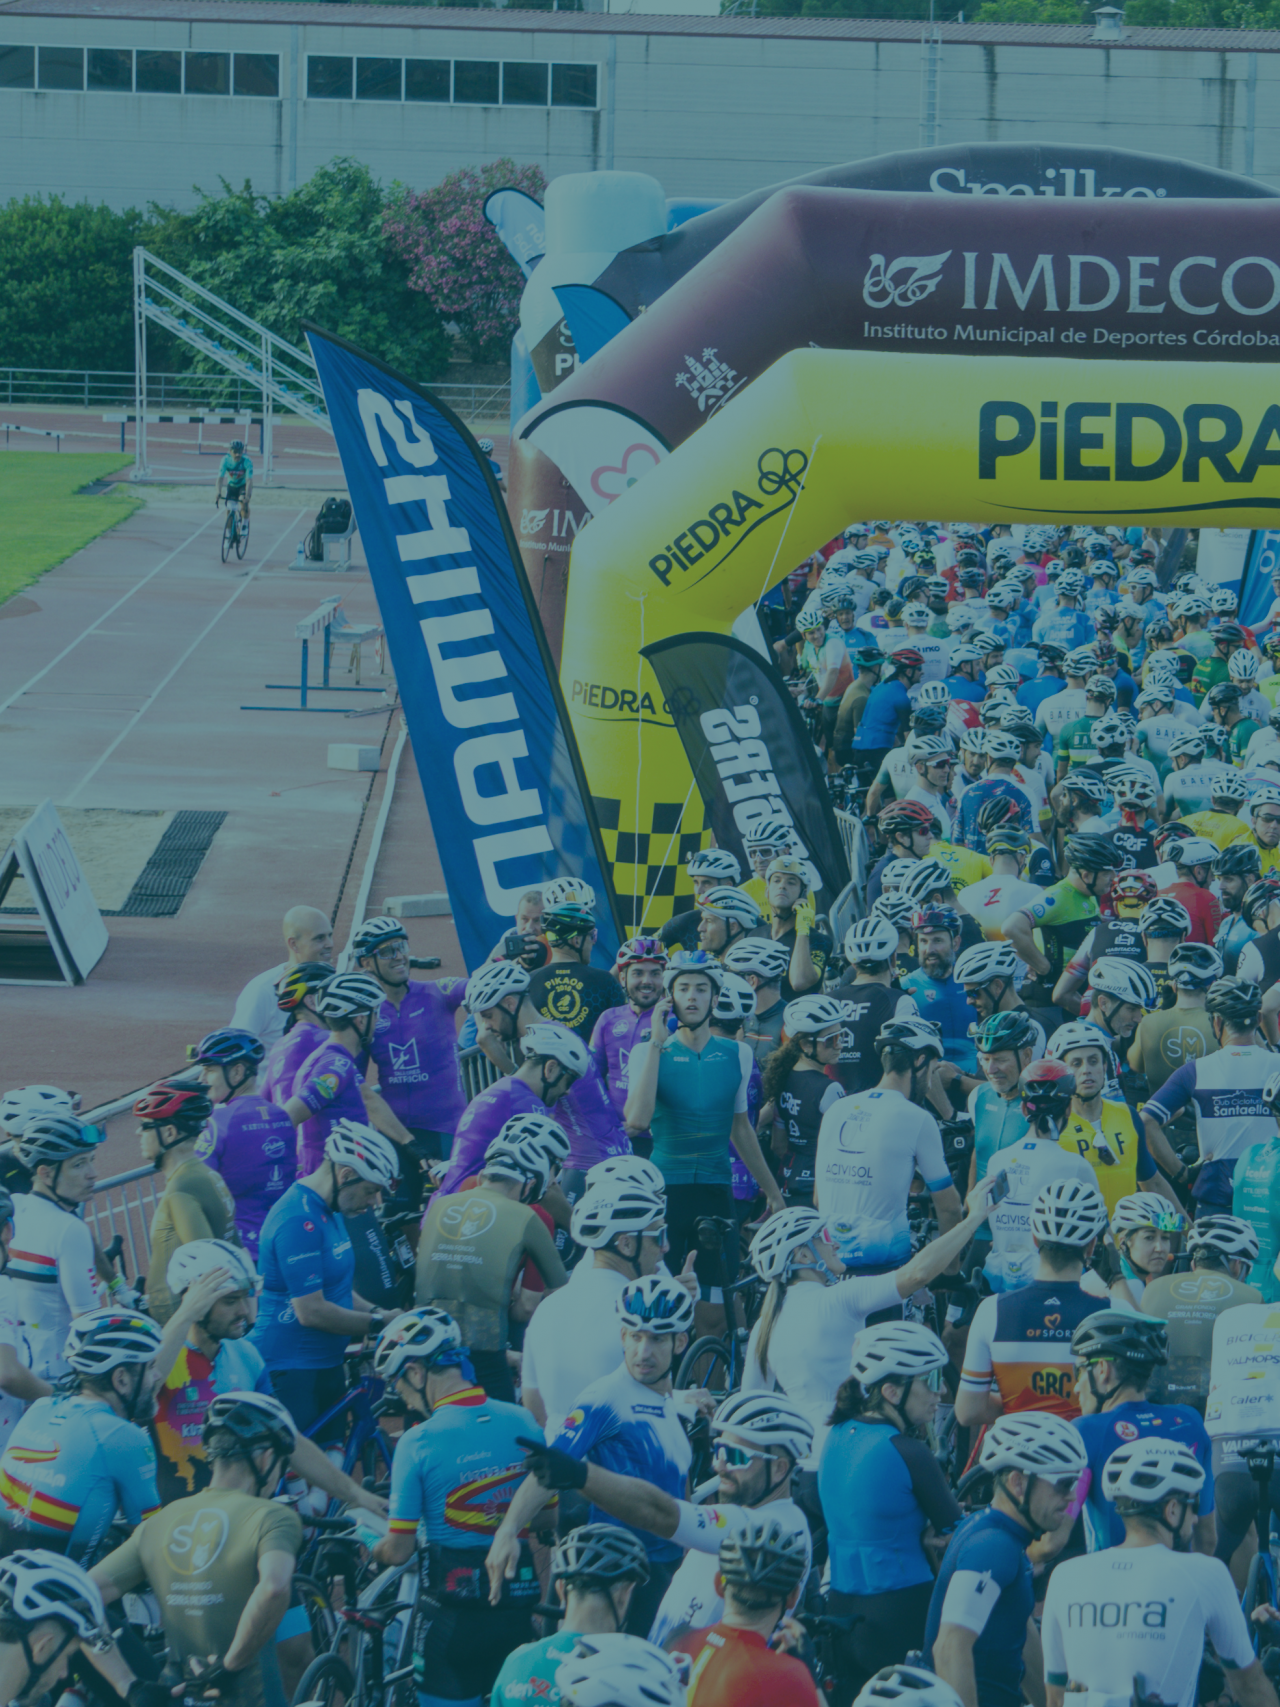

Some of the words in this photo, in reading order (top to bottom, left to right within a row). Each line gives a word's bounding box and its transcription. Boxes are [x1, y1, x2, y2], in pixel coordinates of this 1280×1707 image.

[862, 321, 949, 341] Instituto
[954, 323, 1055, 345] Municipal
[1060, 326, 1088, 344] de
[1092, 328, 1187, 348] Deportes
[1192, 328, 1280, 347] Córdoba
[543, 976, 585, 990] PIKAOS
[388, 1073, 429, 1084] PATRICIO
[1213, 1098, 1230, 1106] Club
[1212, 1104, 1270, 1118] Santaella
[825, 1163, 874, 1179] ACIVISOL
[1167, 1311, 1188, 1319] SIERRA
[1189, 1311, 1218, 1320] MOREN
[1031, 1370, 1072, 1399] GRC
[1067, 1600, 1168, 1629] mora
[1116, 1631, 1167, 1641] armarios
